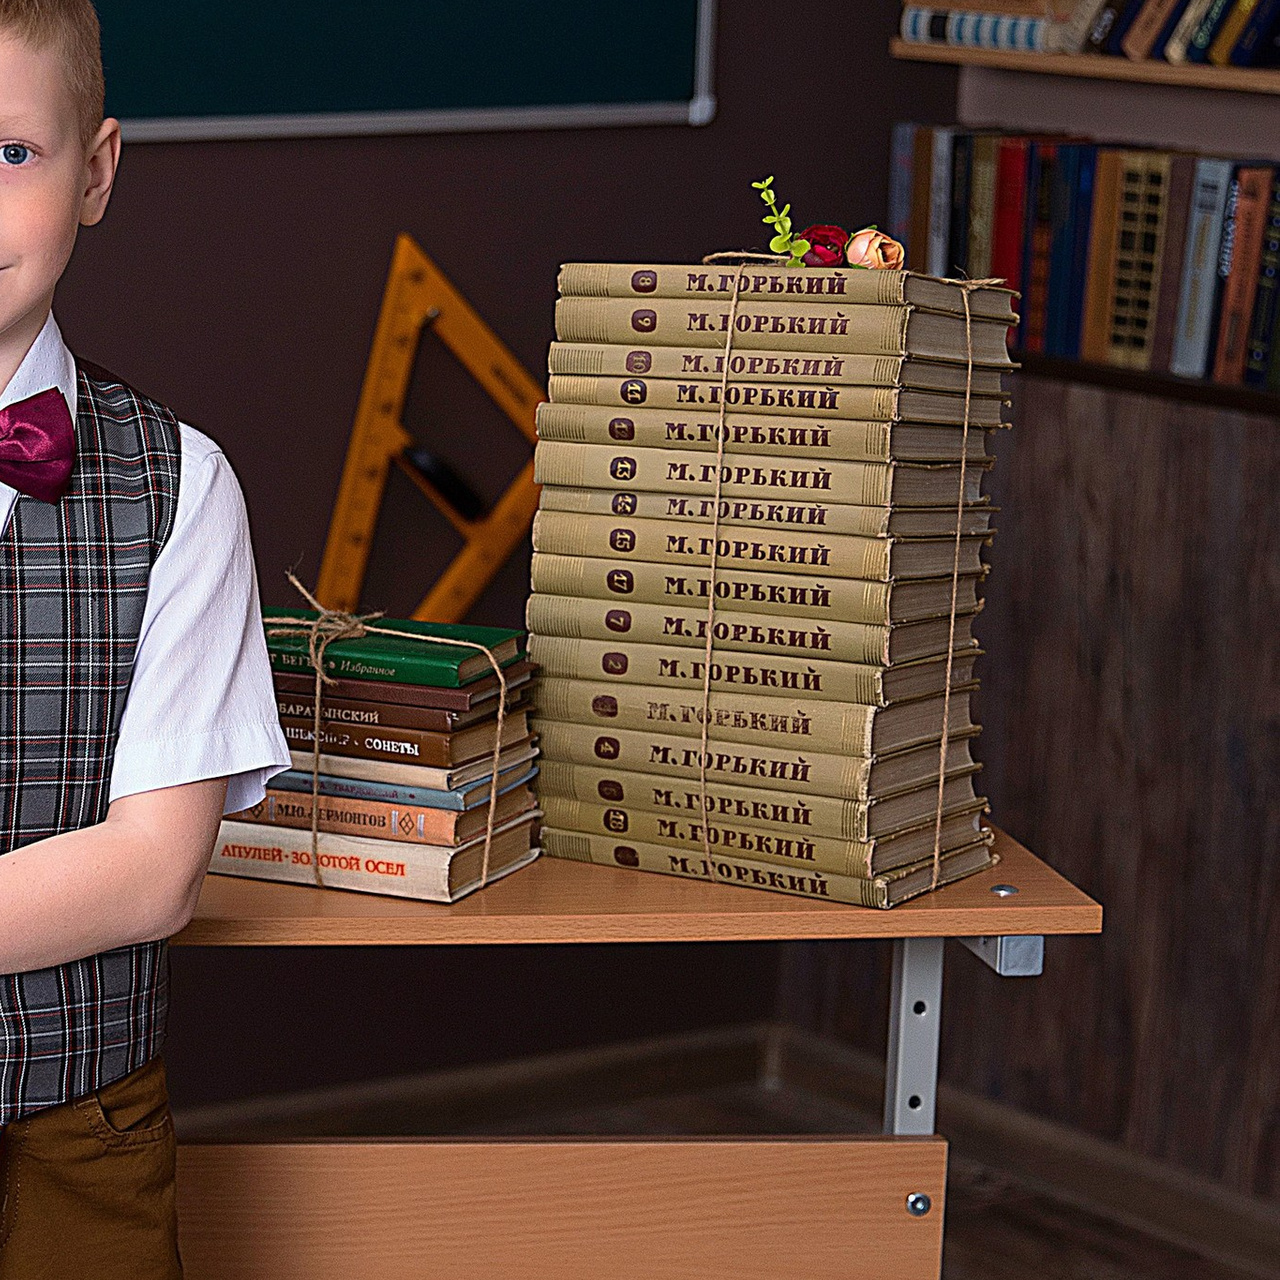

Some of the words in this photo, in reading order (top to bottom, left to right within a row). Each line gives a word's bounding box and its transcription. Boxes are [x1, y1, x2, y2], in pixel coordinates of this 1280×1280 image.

[639, 276, 653, 286] 8
[626, 382, 642, 402] 11
[616, 460, 632, 479] 13
[615, 531, 631, 550] 15
[612, 572, 628, 591] 17
[610, 616, 624, 626] 7
[340, 660, 396, 676] Избранное
[607, 659, 622, 670] 2
[279, 703, 380, 724] БАРАЫНСКИЙ
[364, 738, 420, 756] СОНЕТЫ
[600, 741, 614, 754] 4
[610, 811, 625, 830] 18
[221, 844, 283, 862] АПУЛЕЙ
[365, 860, 406, 876] ОСЕЛ
